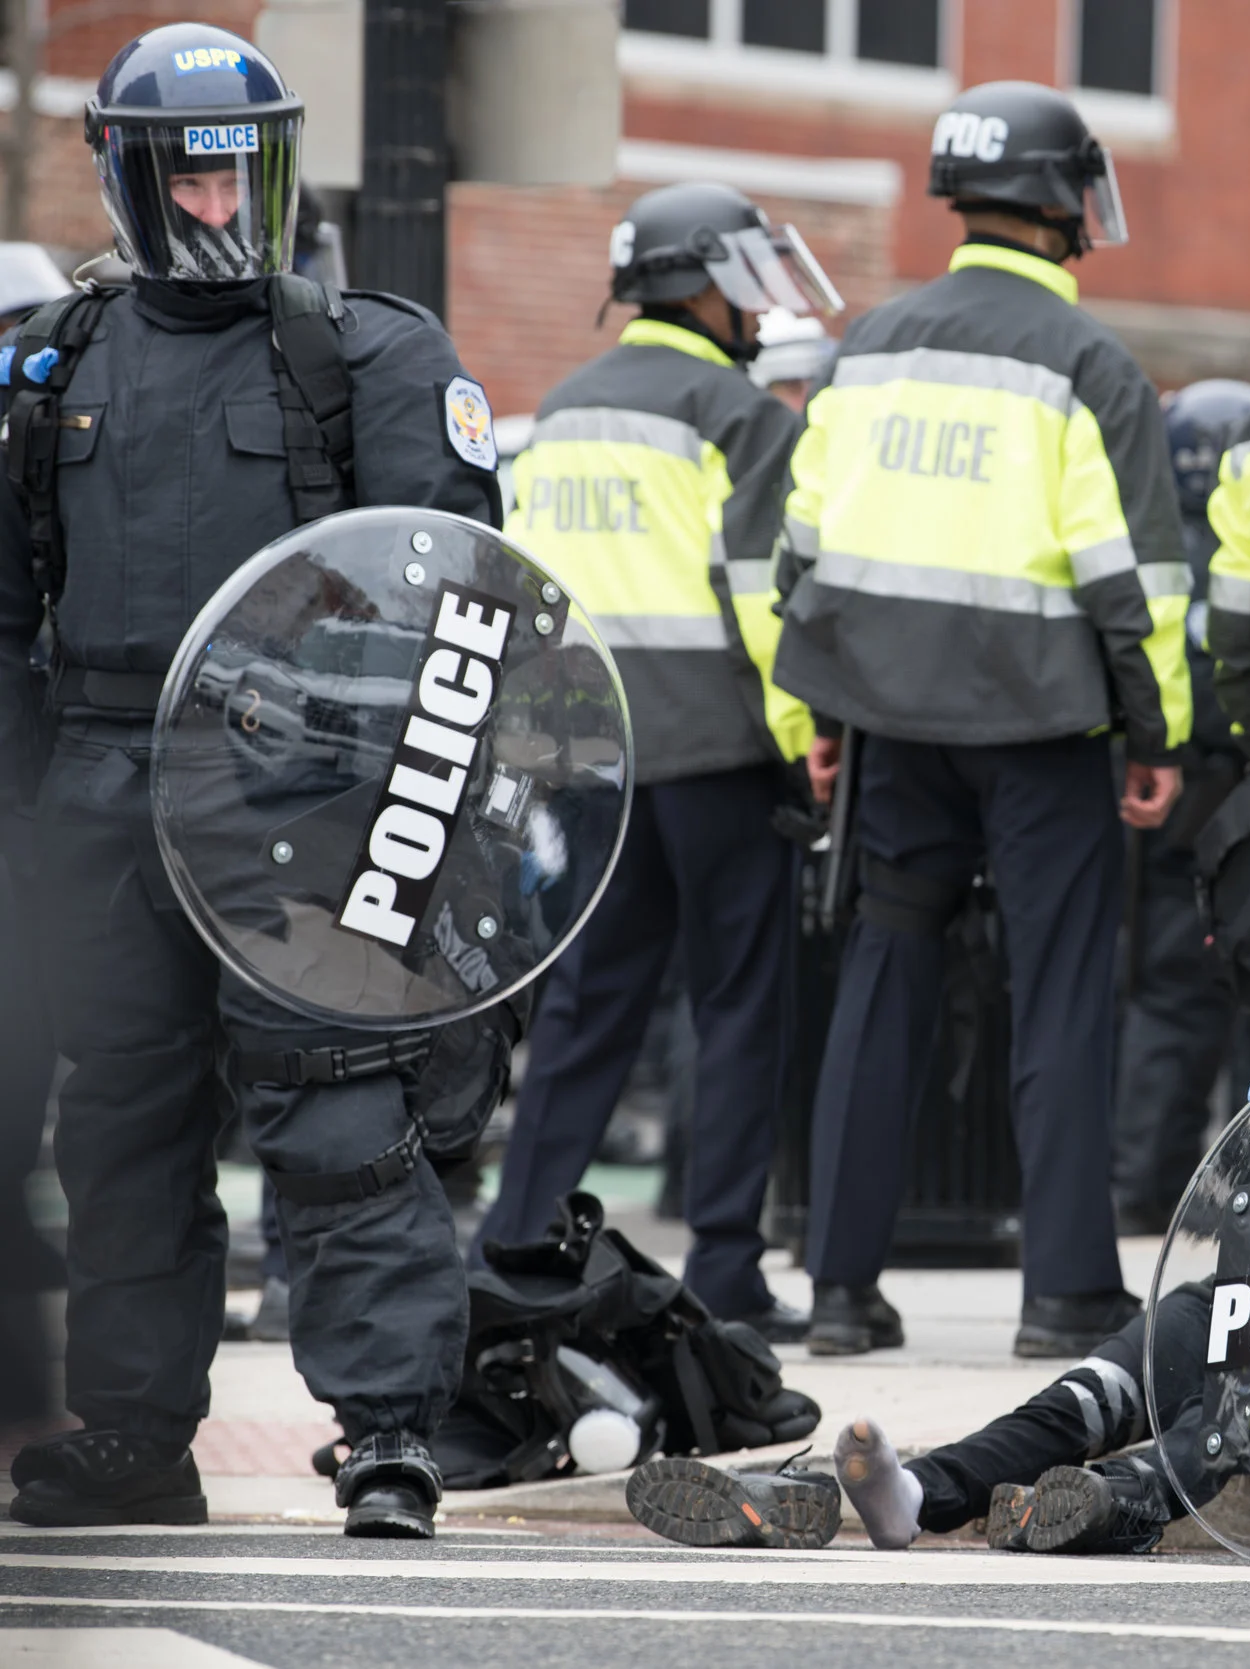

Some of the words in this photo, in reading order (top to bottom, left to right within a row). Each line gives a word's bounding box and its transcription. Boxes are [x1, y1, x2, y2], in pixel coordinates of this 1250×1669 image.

[174, 48, 241, 71] USPP
[188, 125, 256, 151] POLICE
[932, 112, 1009, 163] PDC
[868, 412, 998, 484] OLICE
[526, 475, 649, 534] POLICE
[339, 590, 511, 948] POLICE
